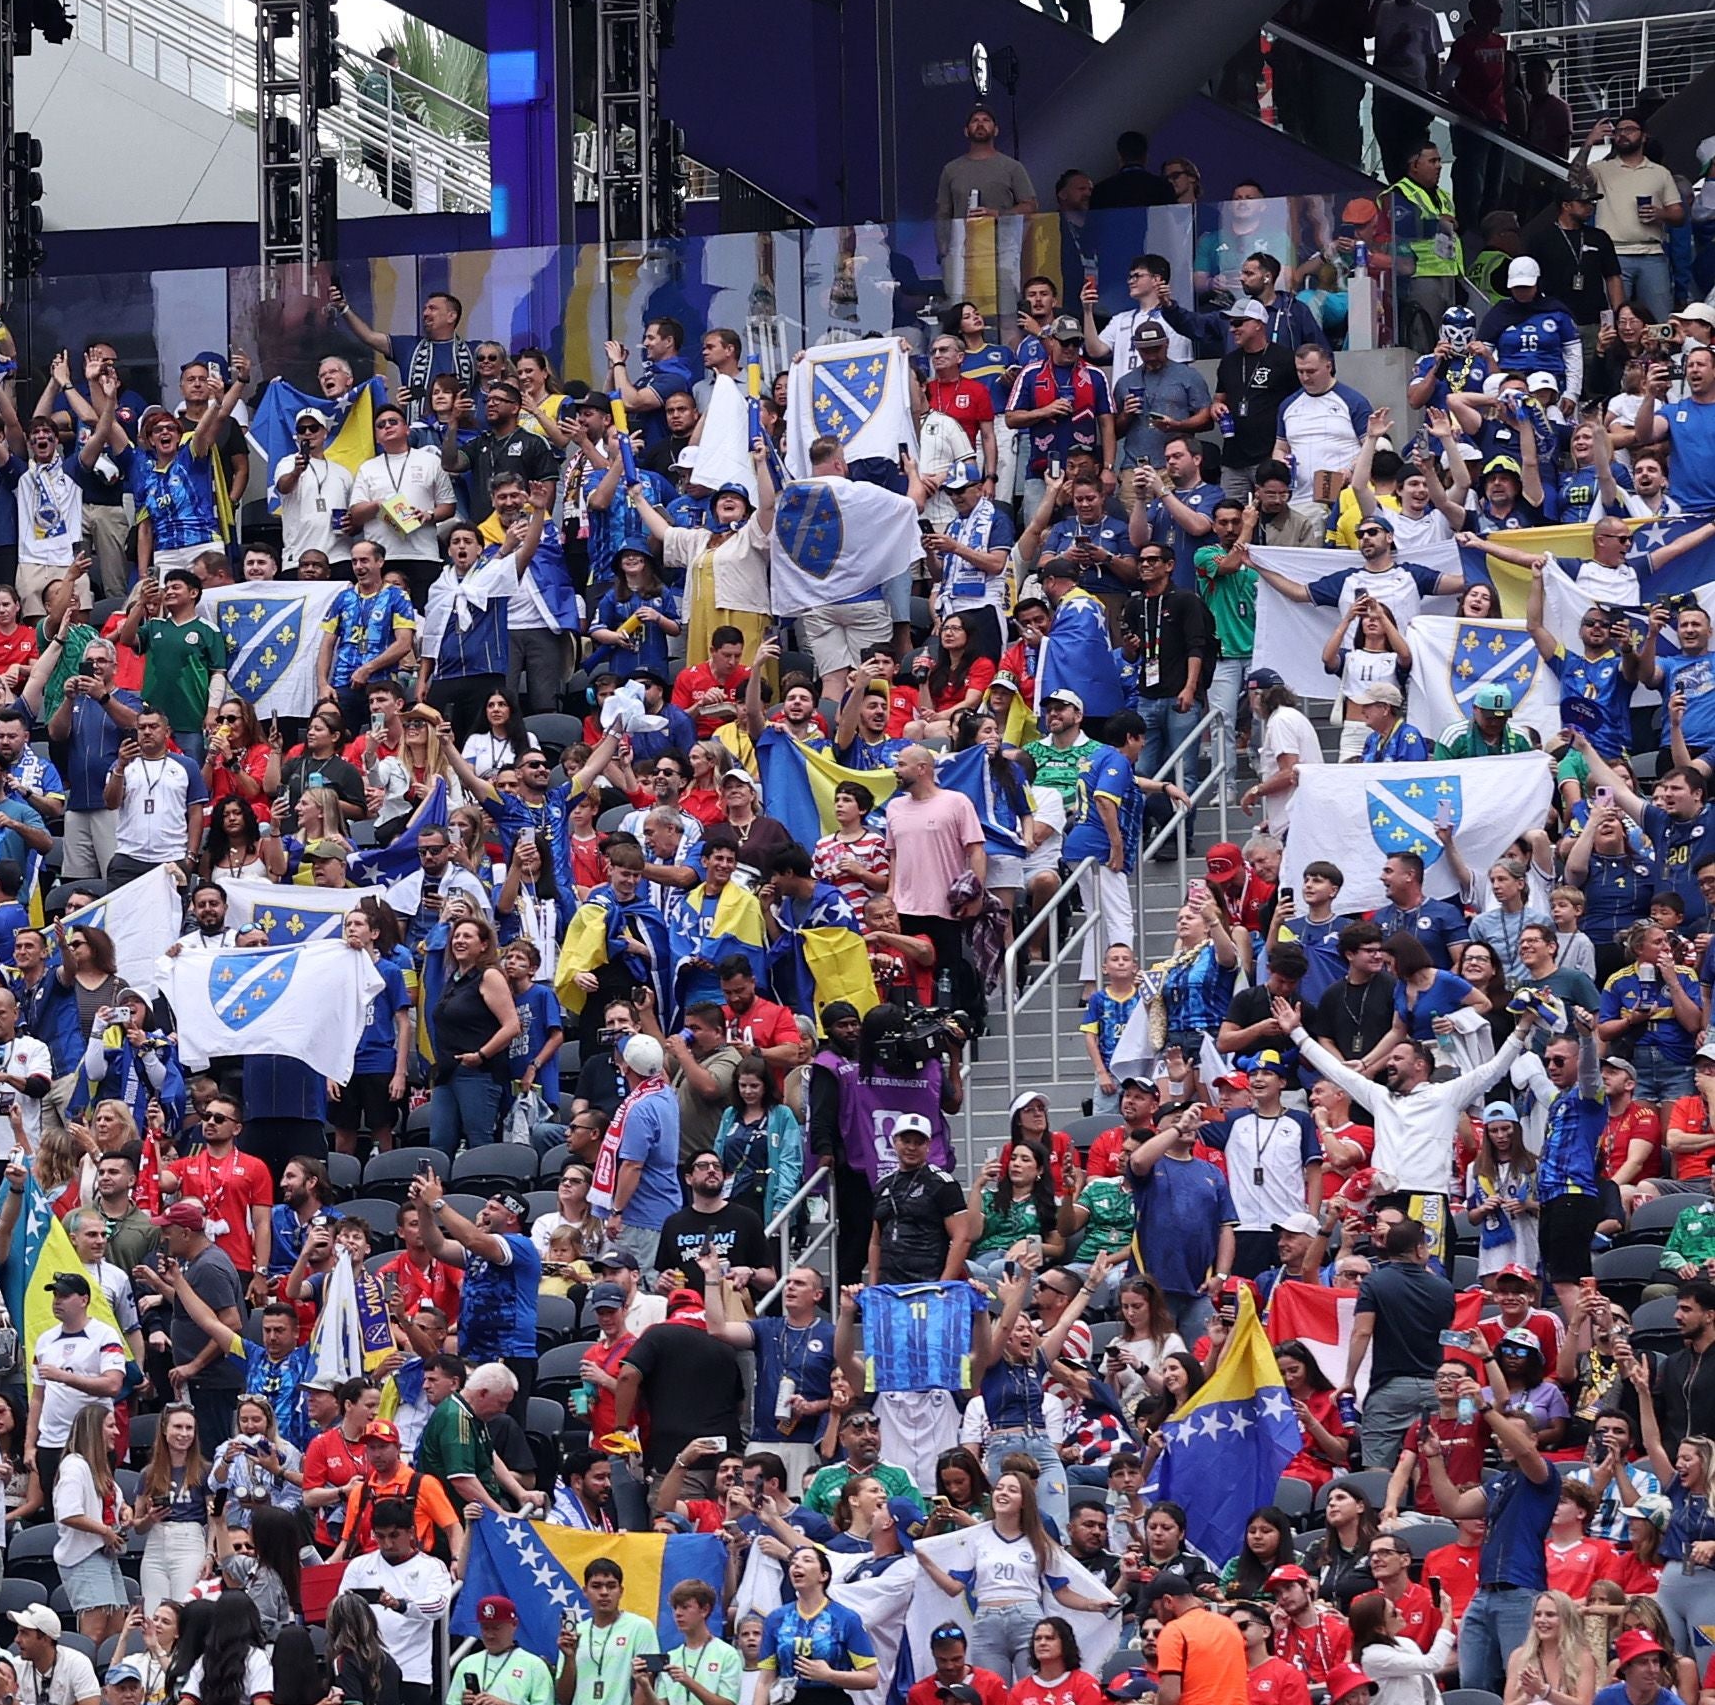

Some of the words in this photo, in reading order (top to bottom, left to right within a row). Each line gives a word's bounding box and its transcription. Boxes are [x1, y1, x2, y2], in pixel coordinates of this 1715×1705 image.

[1520, 335, 1538, 352] 16
[1360, 666, 1372, 681] 11
[910, 1303, 927, 1319] 11
[994, 1563, 1015, 1580] 20
